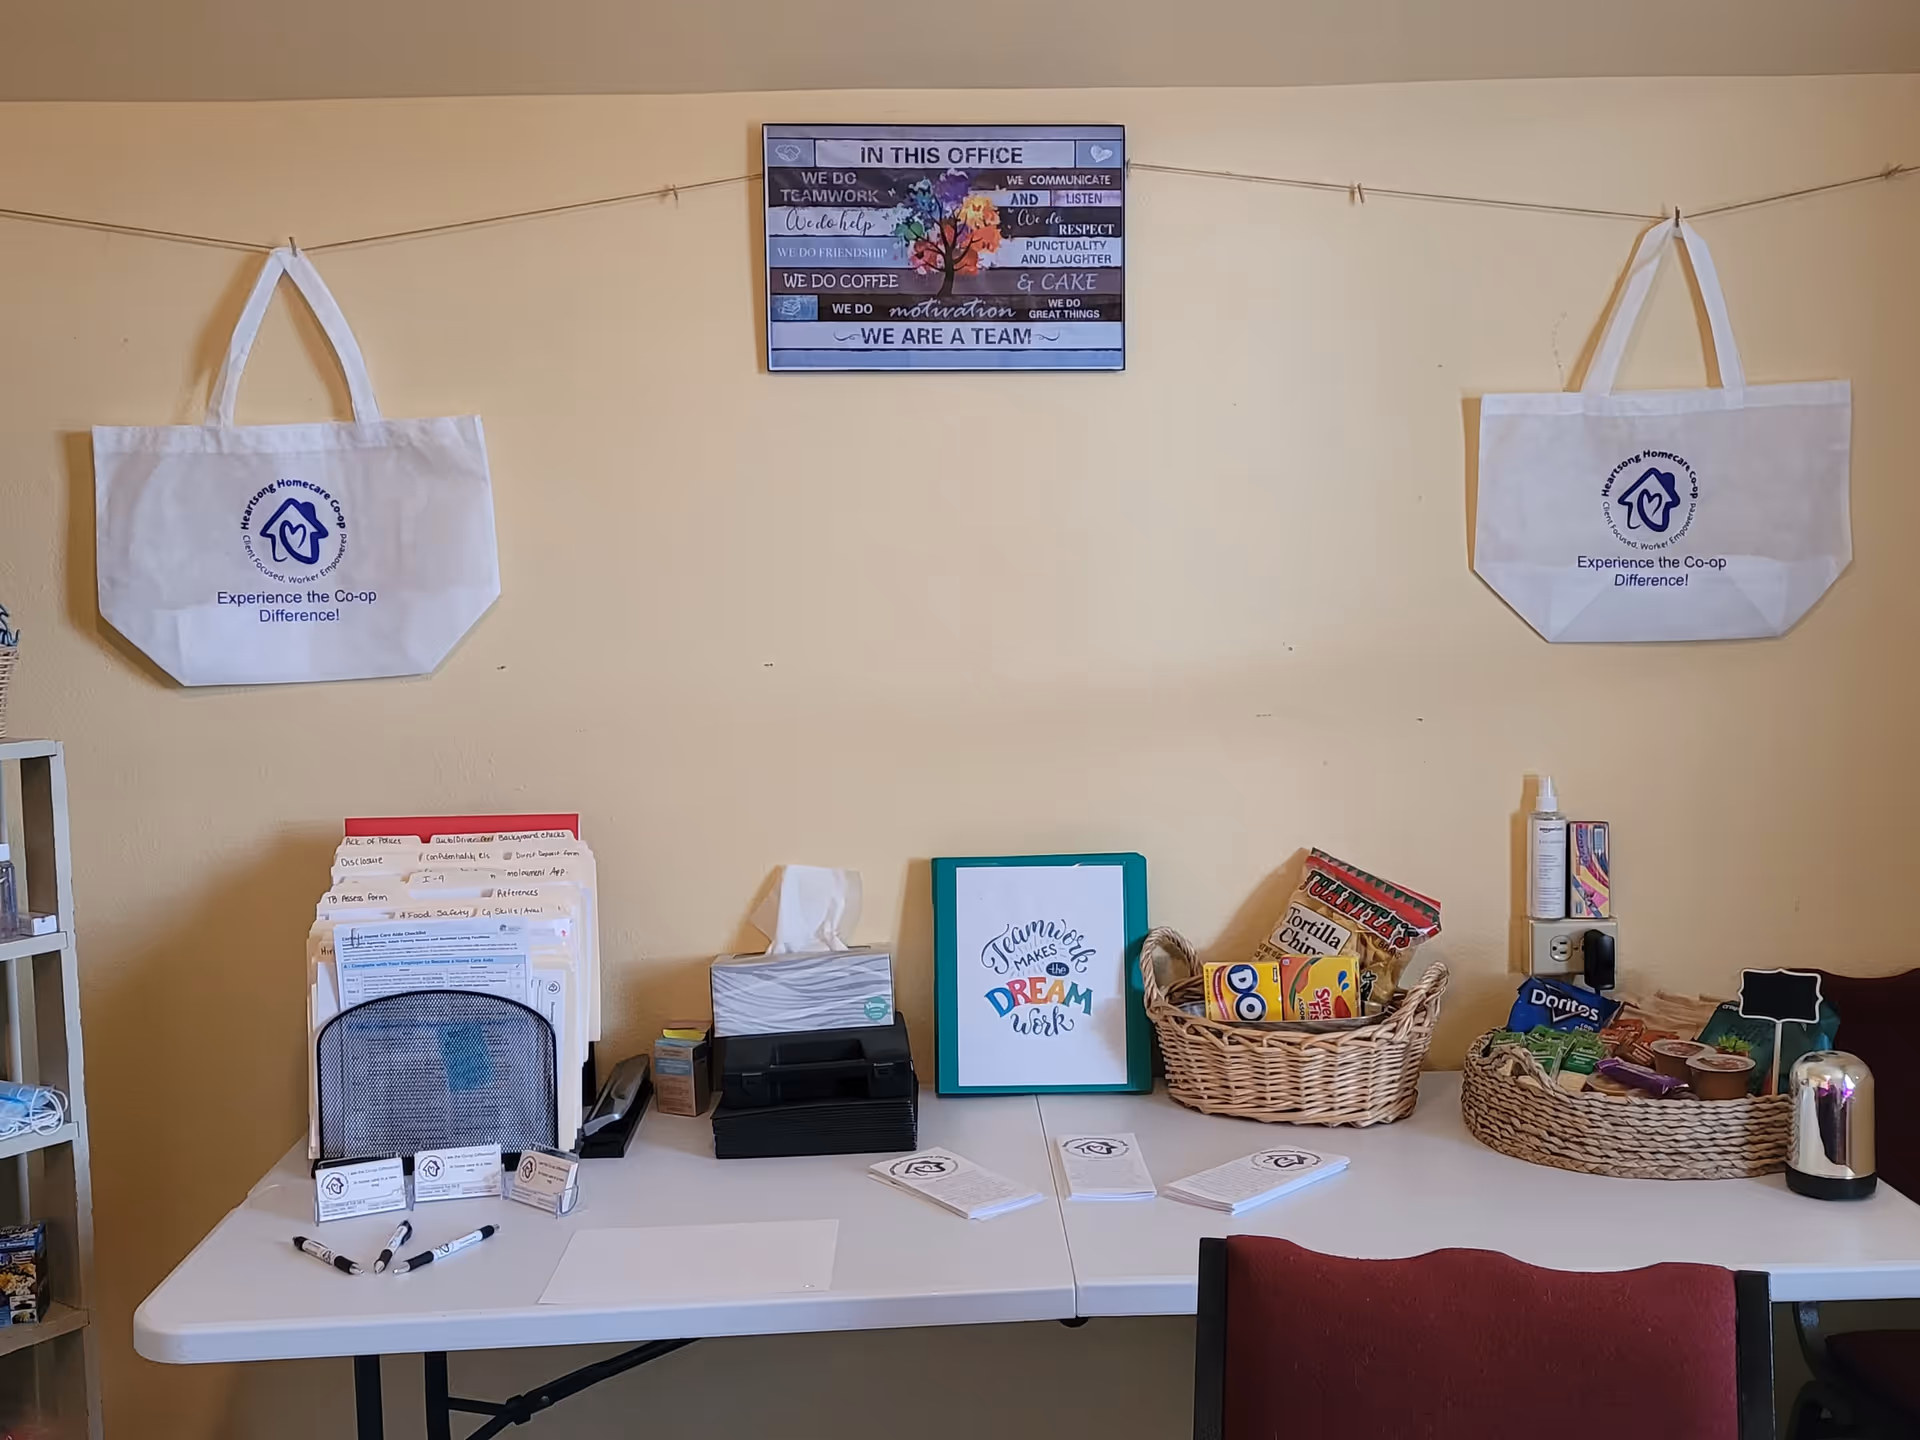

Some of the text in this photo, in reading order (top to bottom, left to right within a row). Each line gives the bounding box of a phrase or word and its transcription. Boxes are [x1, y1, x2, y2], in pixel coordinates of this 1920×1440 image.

[861, 147, 1023, 164] IN THIS OFFICE
[802, 172, 857, 184] WE DO
[1006, 175, 1111, 185] WE COMMUNICATE
[780, 189, 880, 203] TEAMWORK
[1010, 193, 1038, 205] AND
[1066, 193, 1102, 204] LISTEN
[786, 208, 875, 236] We do help
[1018, 208, 1064, 226] We do
[1058, 224, 1115, 235] RESPECT
[1026, 240, 1106, 250] PUNCTUALITY
[778, 248, 888, 258] WE DO FRIENDSHIP
[1021, 254, 1112, 264] AND LAUGHTER
[783, 272, 899, 288] WE DO COFFEE
[1017, 273, 1098, 292] & CAKE
[832, 298, 1016, 318] WE DO motivation
[1048, 298, 1080, 308] WE DO
[1028, 310, 1100, 318] GREAT THINGS
[861, 328, 1032, 344] WE ARE A TEAM
[1601, 450, 1698, 499] Heartsong Homecare Co-op
[240, 478, 346, 530] Heartsong Homecare Co-op
[1602, 502, 1612, 525] Client
[1640, 540, 1669, 550] Worker
[1668, 503, 1696, 545] Empowered
[242, 535, 254, 559] Client
[288, 573, 320, 584] Worker
[320, 534, 347, 578] Empowered
[1577, 556, 1727, 570] Experience the Co-op
[1614, 574, 1688, 586] Difference!
[217, 589, 377, 606] Experience the Co-op
[259, 608, 340, 622] Difference!
[341, 856, 383, 866] Disclosure
[496, 888, 539, 898] References
[436, 908, 469, 918] Safety
[1286, 906, 1342, 950] Tortilla
[981, 918, 1096, 974] Teamwork
[1014, 944, 1058, 971] MAKES
[1049, 964, 1066, 975] the
[984, 976, 1093, 1018] DREAM
[1530, 988, 1600, 1021] Doritos
